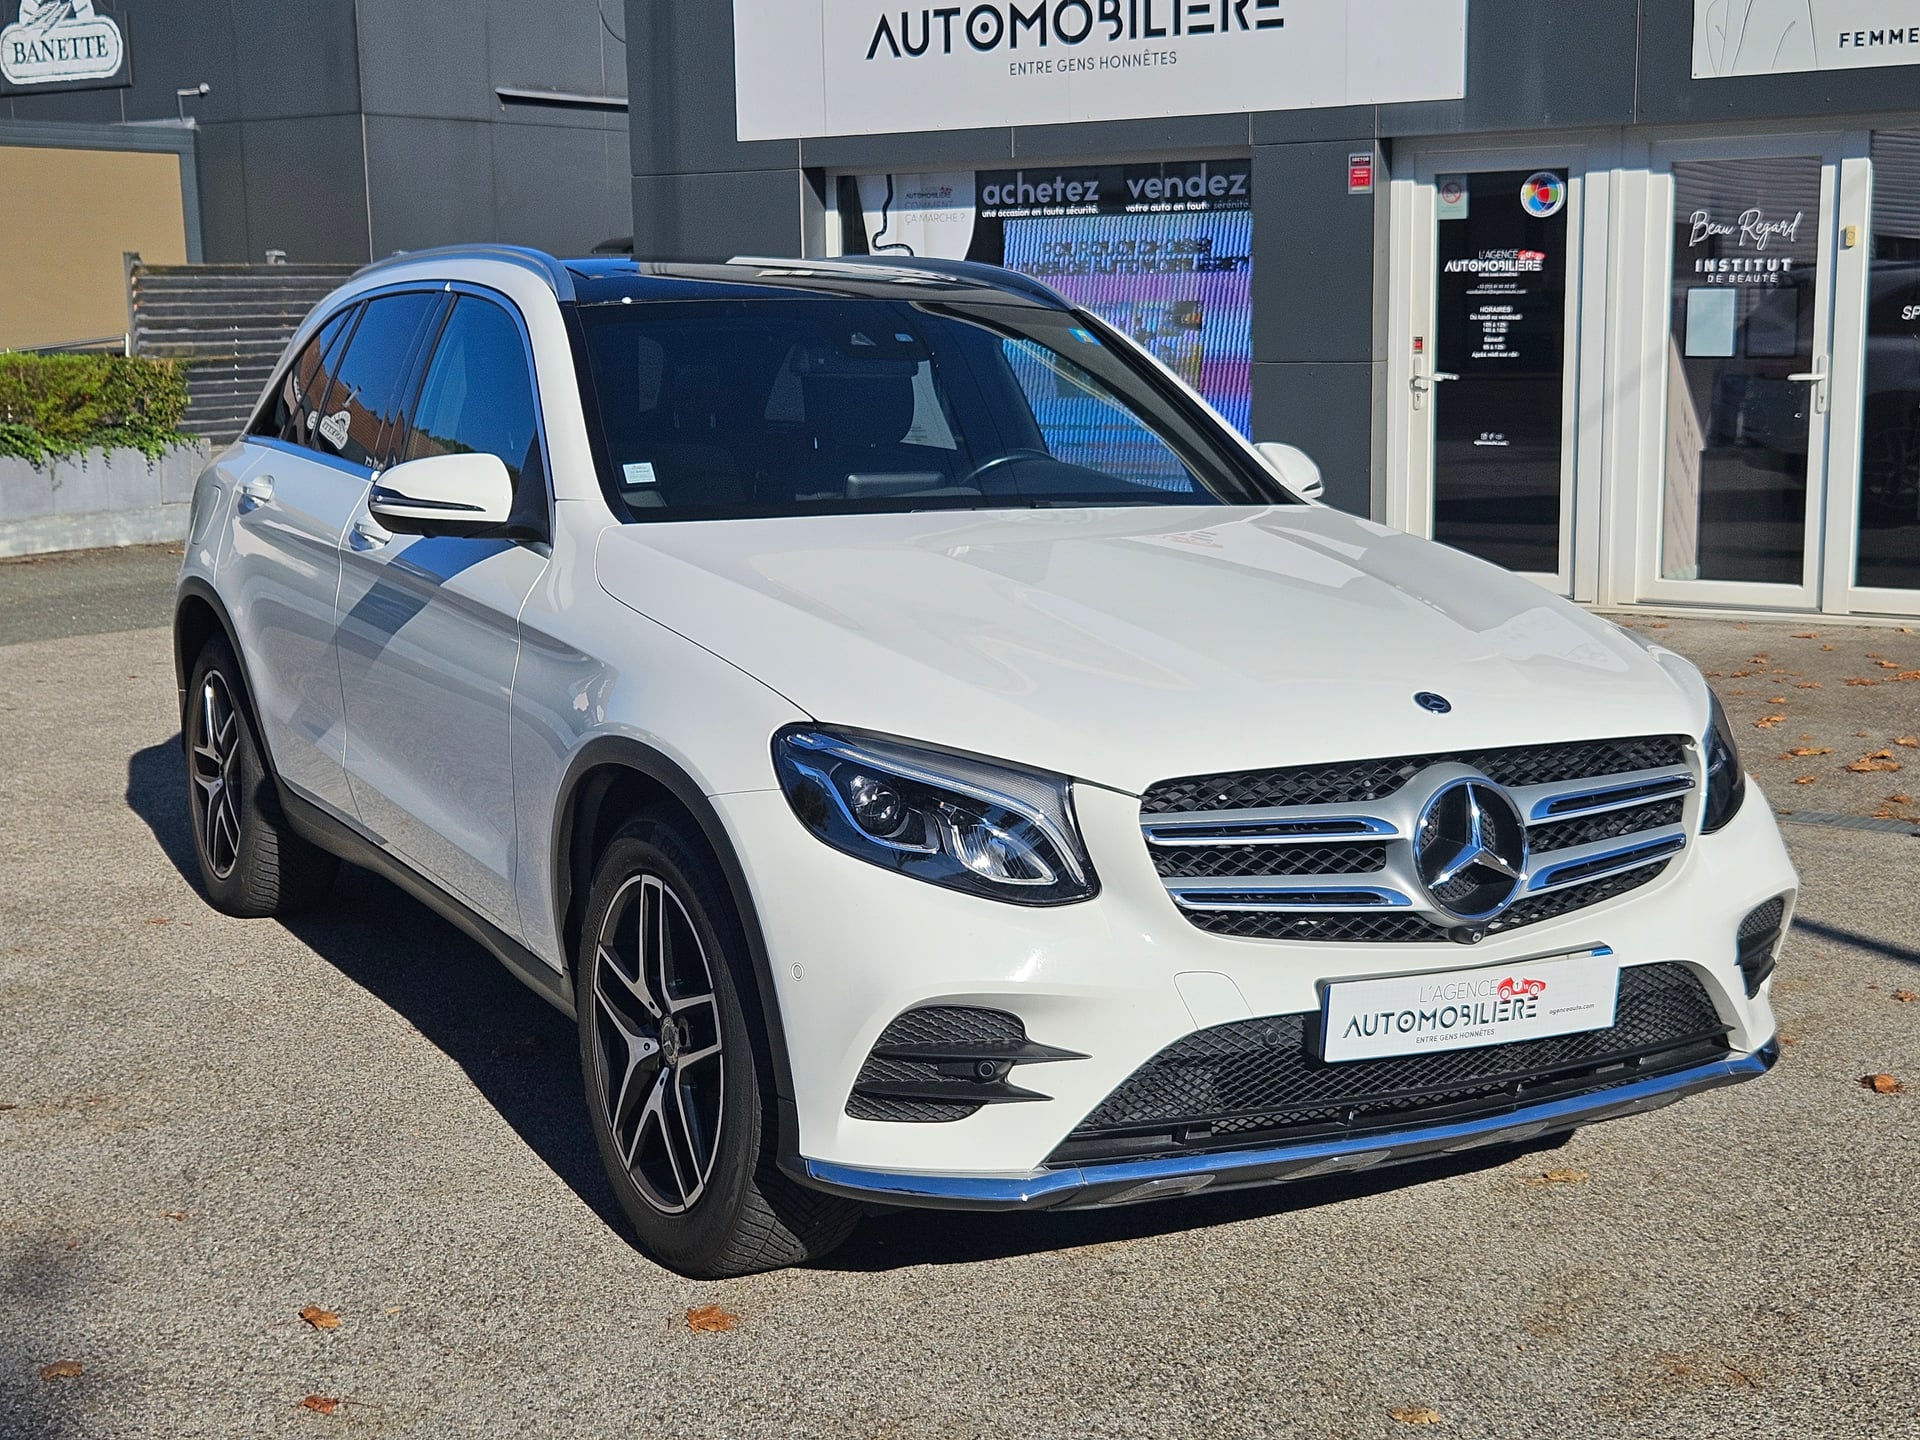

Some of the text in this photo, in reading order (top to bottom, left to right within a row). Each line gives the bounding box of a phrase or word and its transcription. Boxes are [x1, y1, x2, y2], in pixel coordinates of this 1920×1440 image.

[1838, 27, 1919, 48] FEMME
[13, 34, 109, 65] BANETTE
[1009, 49, 1178, 76] ENTRE GENS HONNÊTES
[982, 171, 1100, 205] achetez
[1126, 162, 1248, 199] vendez
[981, 210, 996, 218] une
[997, 207, 1030, 217] occasion
[1043, 206, 1064, 216] toute
[1125, 203, 1149, 213] votre
[1150, 202, 1171, 212] auto
[1173, 203, 1184, 211] en
[1186, 200, 1210, 210] toute
[919, 213, 957, 223] MARCHE
[1688, 208, 1803, 250] Beau Regard
[1478, 250, 1519, 259] L'AGENCE
[1695, 258, 1793, 273] INSTITUT
[1707, 272, 1779, 283] DE BEAUTÉ
[1420, 979, 1498, 1002] L'AGENCE
[1416, 1028, 1495, 1044] ENTRE GENS HONNÊTES
